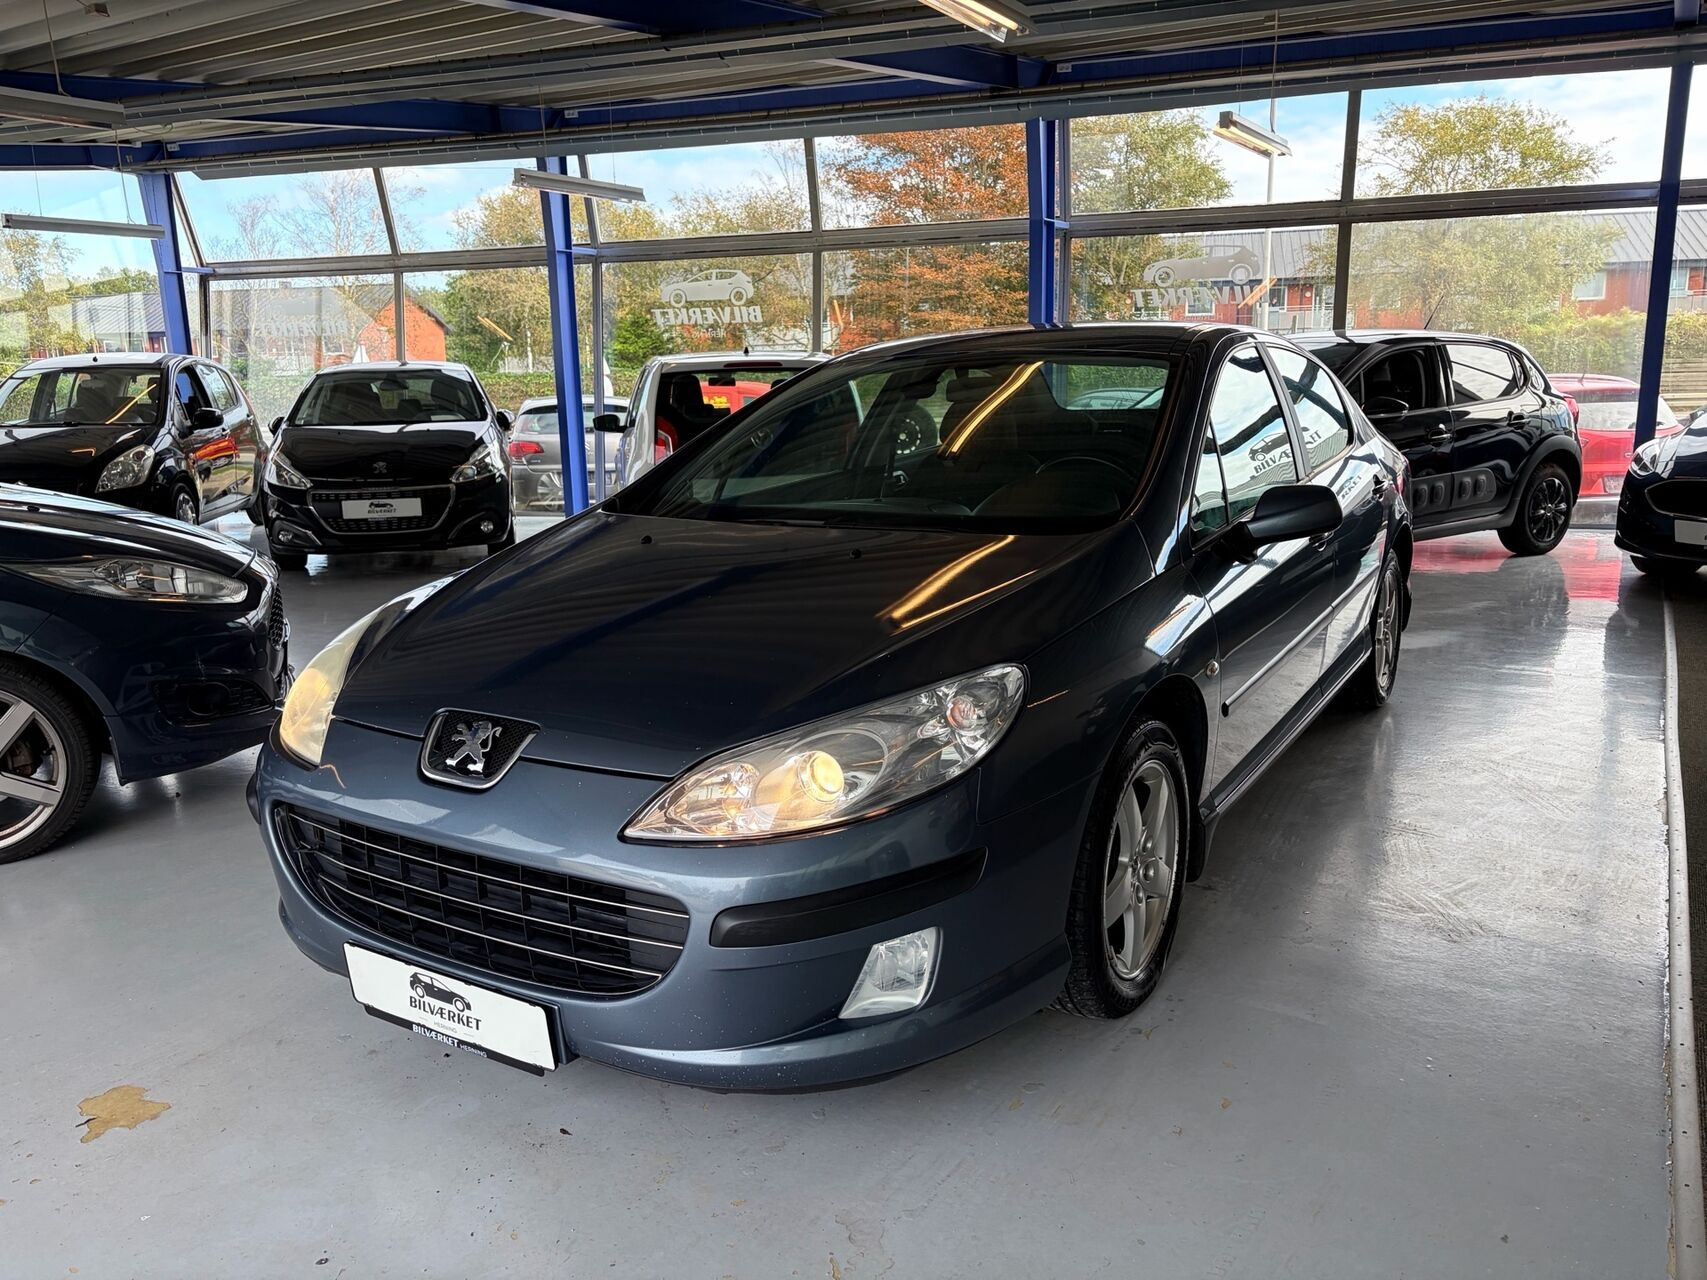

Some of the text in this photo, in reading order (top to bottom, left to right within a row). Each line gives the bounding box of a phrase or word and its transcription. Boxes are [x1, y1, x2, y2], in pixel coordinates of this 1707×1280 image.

[409, 995, 482, 1031] BILVÆRKET
[433, 1020, 458, 1034] HERNING
[412, 1023, 488, 1058] BILVÆRKET HERNING
